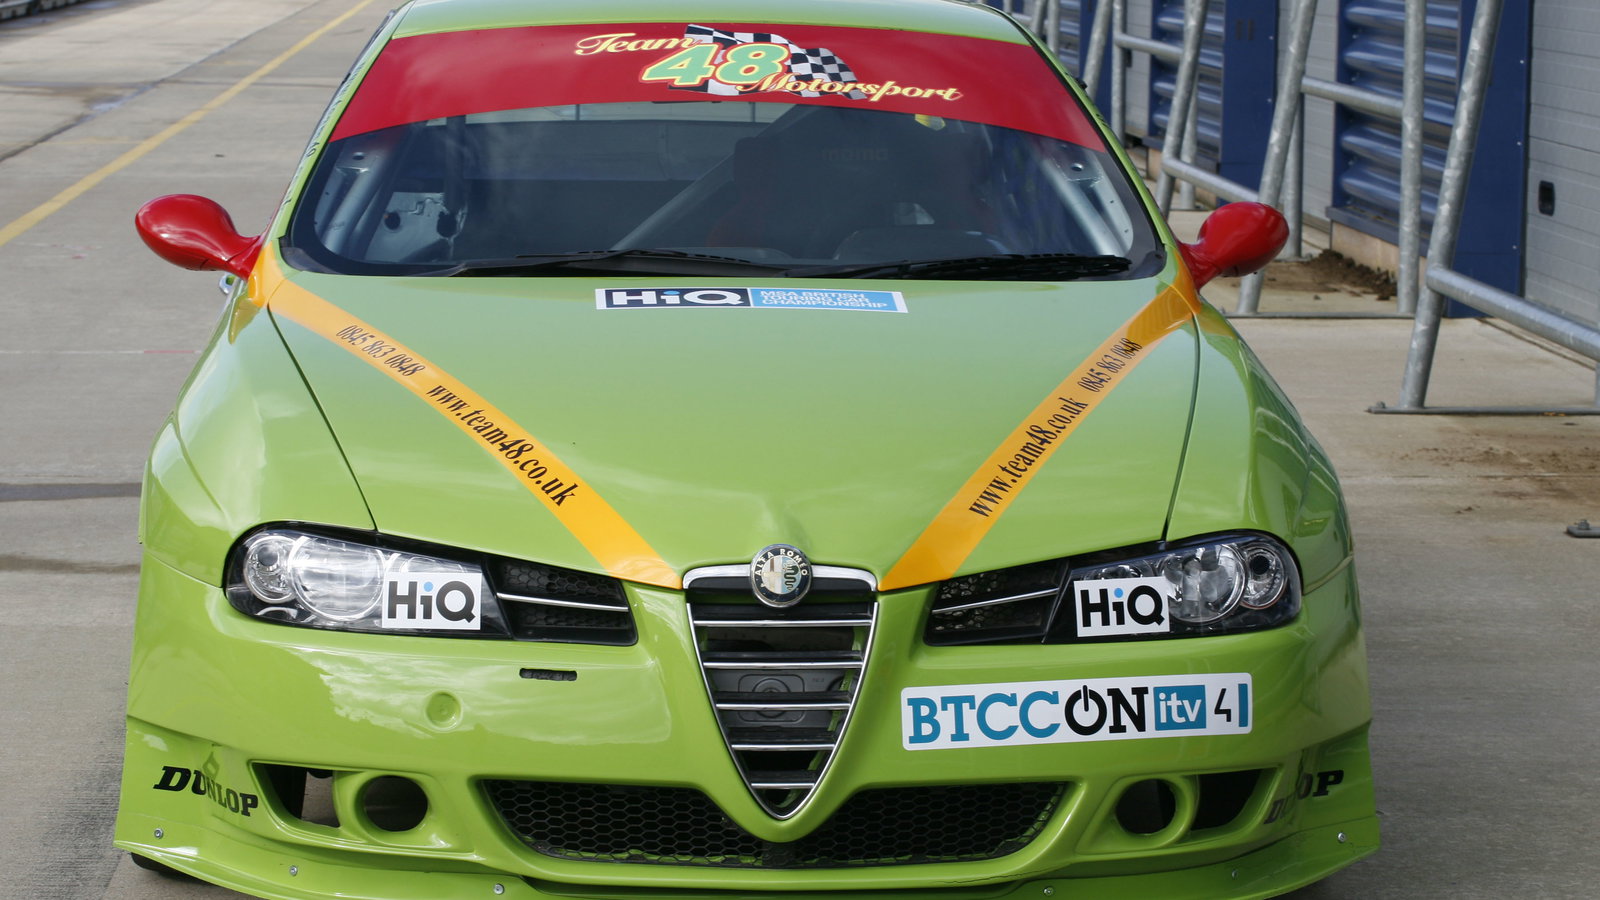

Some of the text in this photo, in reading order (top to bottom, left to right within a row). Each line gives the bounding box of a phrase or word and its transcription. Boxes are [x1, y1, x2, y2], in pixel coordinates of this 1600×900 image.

[575, 33, 700, 57] Team
[641, 42, 789, 87] 48
[735, 72, 964, 102] Motorsport
[612, 290, 745, 306] HiQ
[763, 300, 888, 308] CHAMPIONSHIP
[801, 291, 865, 299] BRITISH
[336, 324, 579, 507] 0845 863 0848 www.team48.co.uk
[968, 337, 1143, 518] www.team48.co.uk 0845 863 0848
[780, 548, 808, 576] ROMEO
[387, 580, 476, 624] HiQ
[1080, 585, 1165, 628] HiQ
[153, 765, 259, 817] DUNLOP
